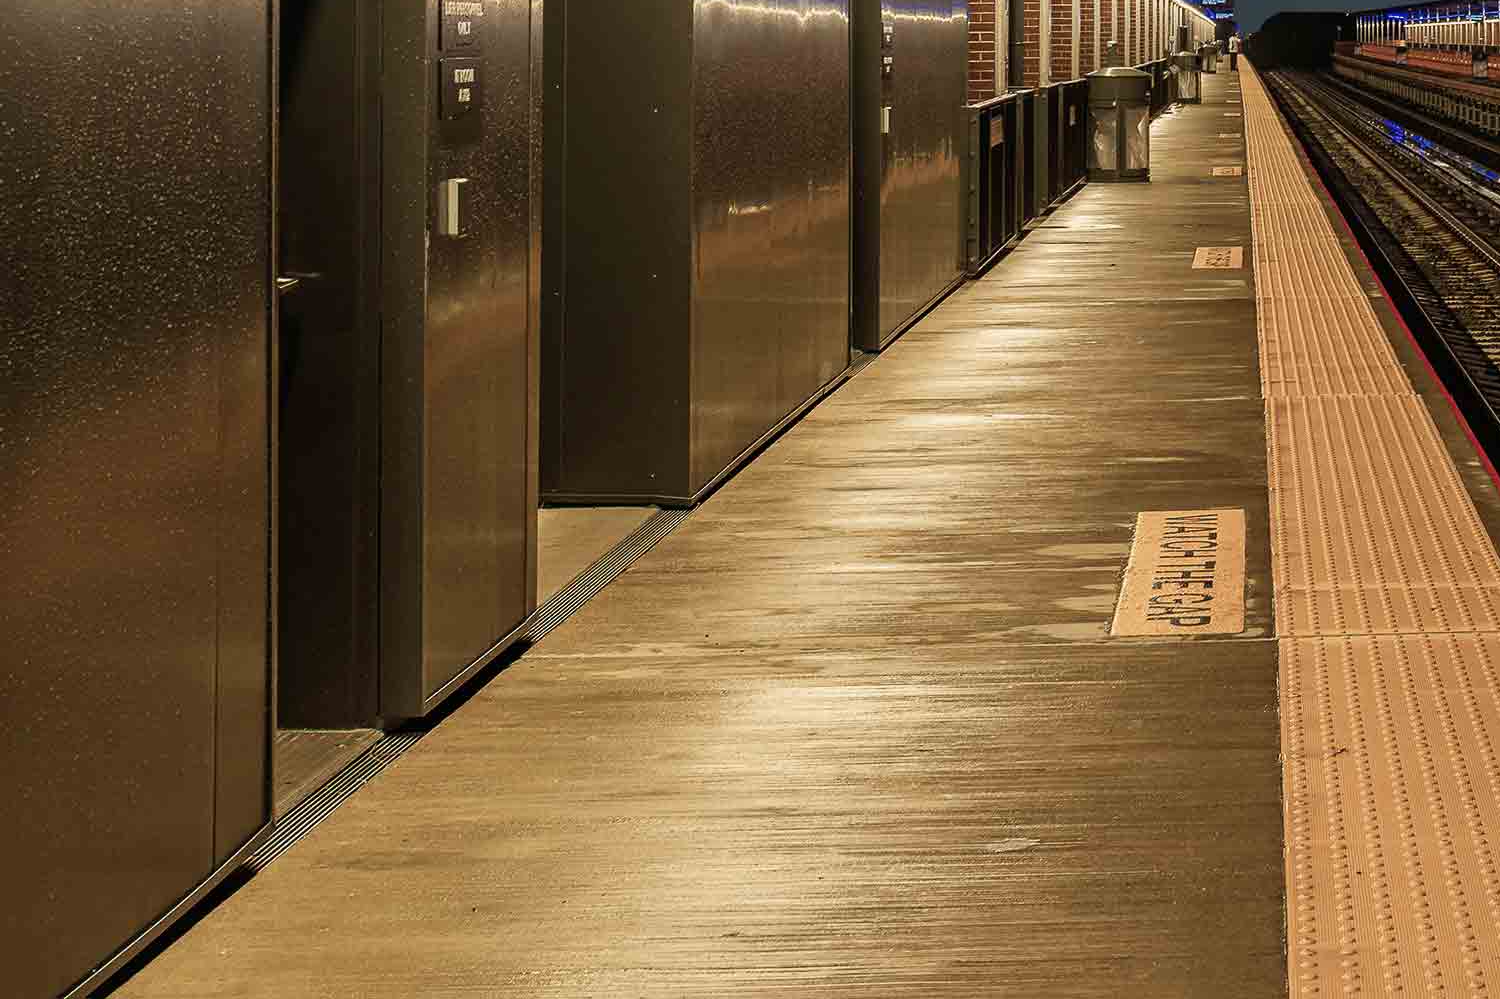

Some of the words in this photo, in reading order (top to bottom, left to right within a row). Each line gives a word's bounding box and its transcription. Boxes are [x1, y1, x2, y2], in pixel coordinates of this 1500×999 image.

[1159, 513, 1219, 559] WATCH
[1151, 560, 1217, 590] THE
[1145, 592, 1215, 627] GAP
